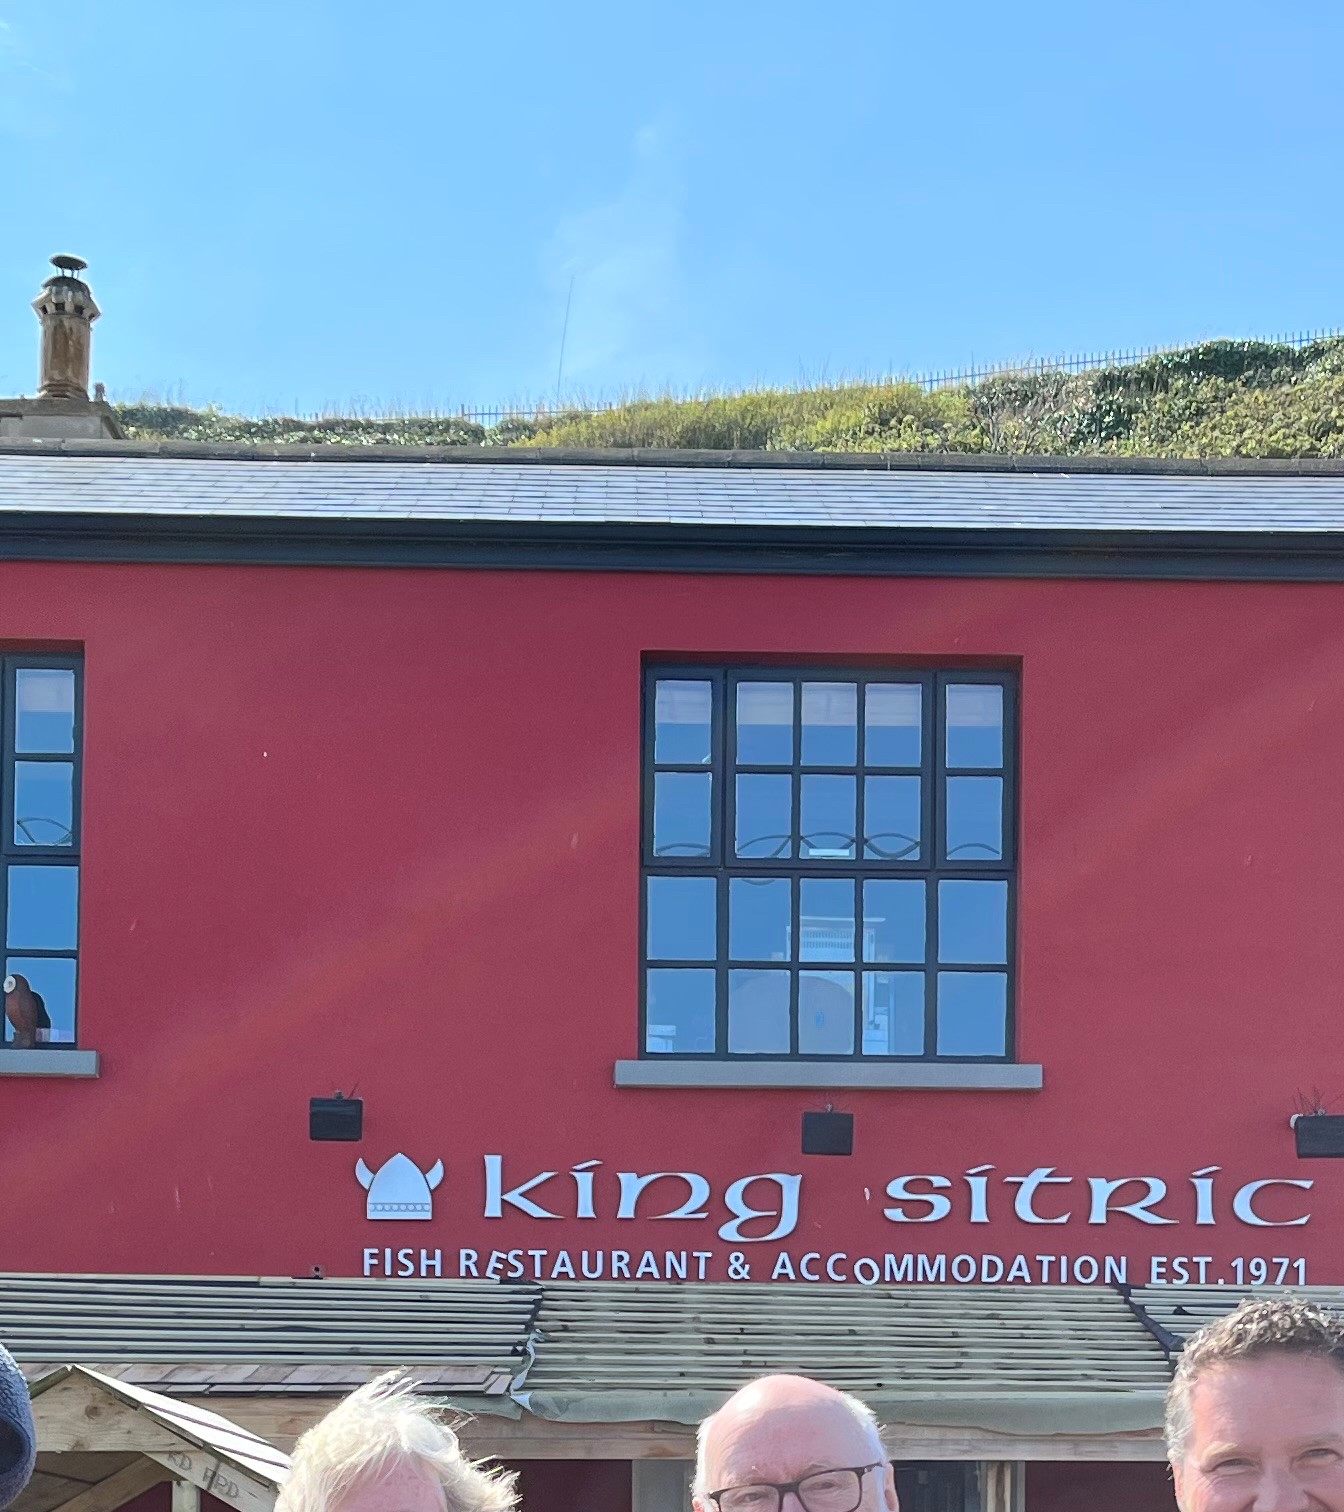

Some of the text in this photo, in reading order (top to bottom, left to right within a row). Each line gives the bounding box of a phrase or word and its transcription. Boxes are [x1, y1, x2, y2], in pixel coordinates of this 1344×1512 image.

[362, 1247, 442, 1278] FISH
[460, 1248, 713, 1281] RESTAURANT
[727, 1250, 751, 1280] &
[771, 1252, 1128, 1286] ACCOMMODATION
